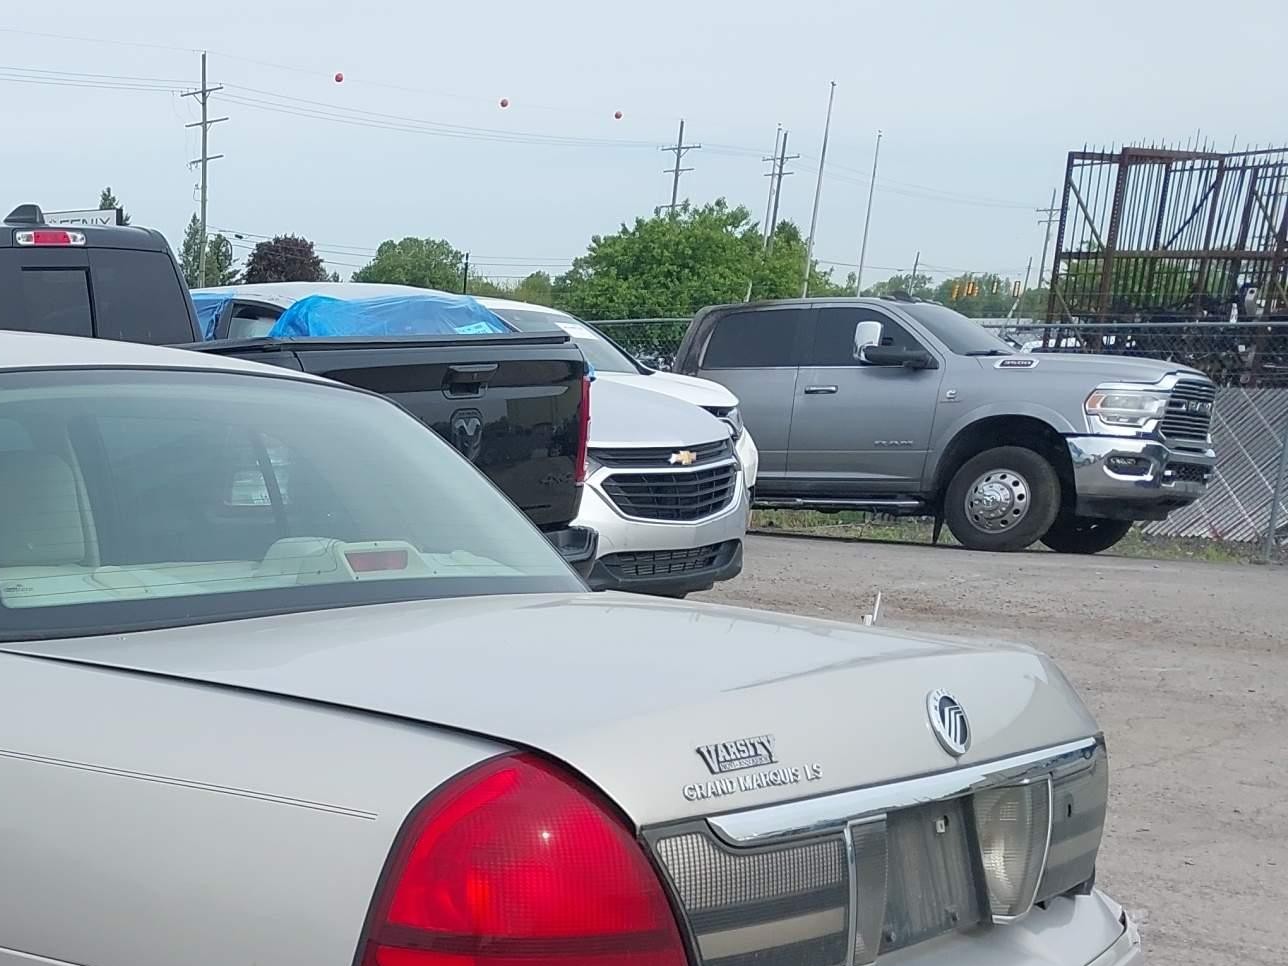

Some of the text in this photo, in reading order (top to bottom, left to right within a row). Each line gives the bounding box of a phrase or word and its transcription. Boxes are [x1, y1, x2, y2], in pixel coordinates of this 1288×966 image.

[695, 734, 777, 775] VARSITY
[683, 762, 824, 801] GRAND MARQUIS LS
